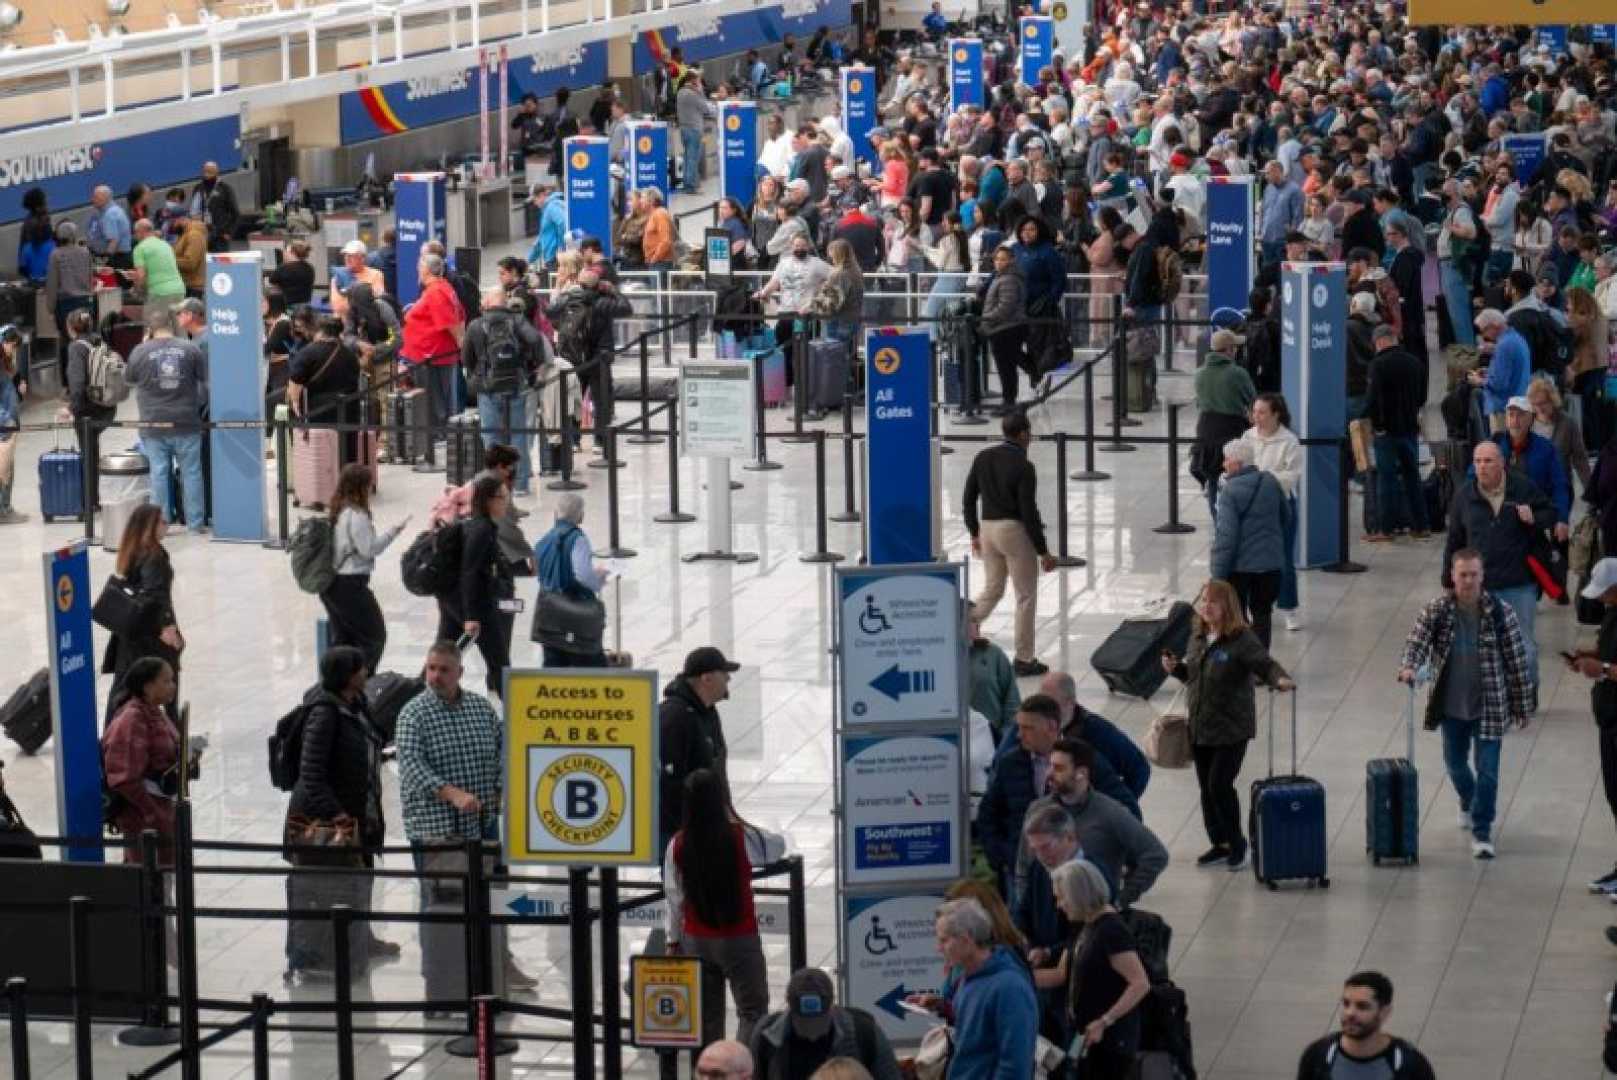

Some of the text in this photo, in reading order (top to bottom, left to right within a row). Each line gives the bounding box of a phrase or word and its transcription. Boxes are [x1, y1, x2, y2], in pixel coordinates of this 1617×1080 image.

[572, 179, 594, 188] Start
[1210, 222, 1243, 235] Priority
[1210, 235, 1232, 244] Lane
[211, 308, 238, 323] Help
[212, 322, 240, 335] Desk
[875, 388, 894, 401] All
[876, 406, 914, 419] Gates
[62, 654, 85, 675] Gates
[537, 684, 625, 699] Access to
[526, 706, 635, 721] Concourses
[544, 727, 619, 742] A, B & C
[547, 757, 617, 779] SECURITY
[566, 780, 599, 820] B
[543, 809, 619, 842] CHECKPOINT
[865, 826, 933, 840] Southwest
